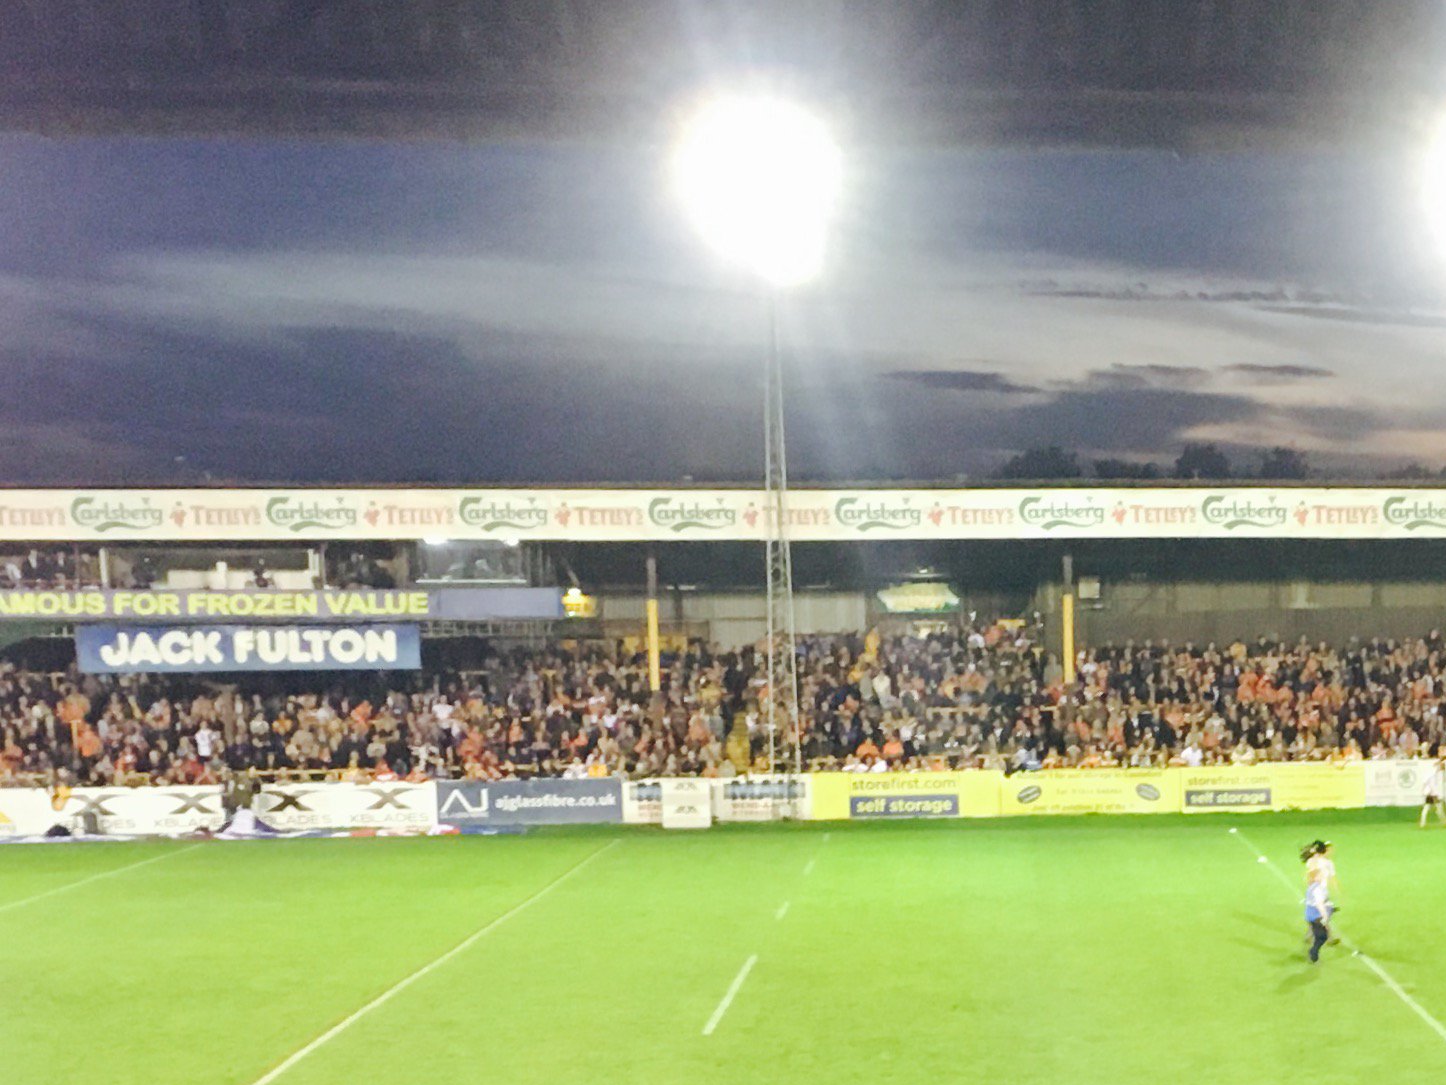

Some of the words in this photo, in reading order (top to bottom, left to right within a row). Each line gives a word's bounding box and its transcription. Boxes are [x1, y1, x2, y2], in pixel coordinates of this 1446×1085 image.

[71, 496, 163, 532] Carlsberg
[266, 496, 357, 532] Carlsberg
[459, 496, 547, 532] Carlsberg
[648, 497, 736, 532] Carlsberg
[762, 505, 830, 526] TTLEY'S
[835, 497, 921, 532] Carlsberg
[1019, 496, 1105, 531] Carlsberg
[1201, 495, 1287, 530] Carlsberg
[112, 592, 181, 615] FOR
[186, 592, 320, 615] FROZEN
[325, 592, 429, 614] VALUE
[99, 631, 225, 667] JACK
[233, 629, 398, 664] FULTON
[851, 778, 956, 791] storefirst.com
[856, 798, 886, 813] self
[889, 799, 953, 814] storage
